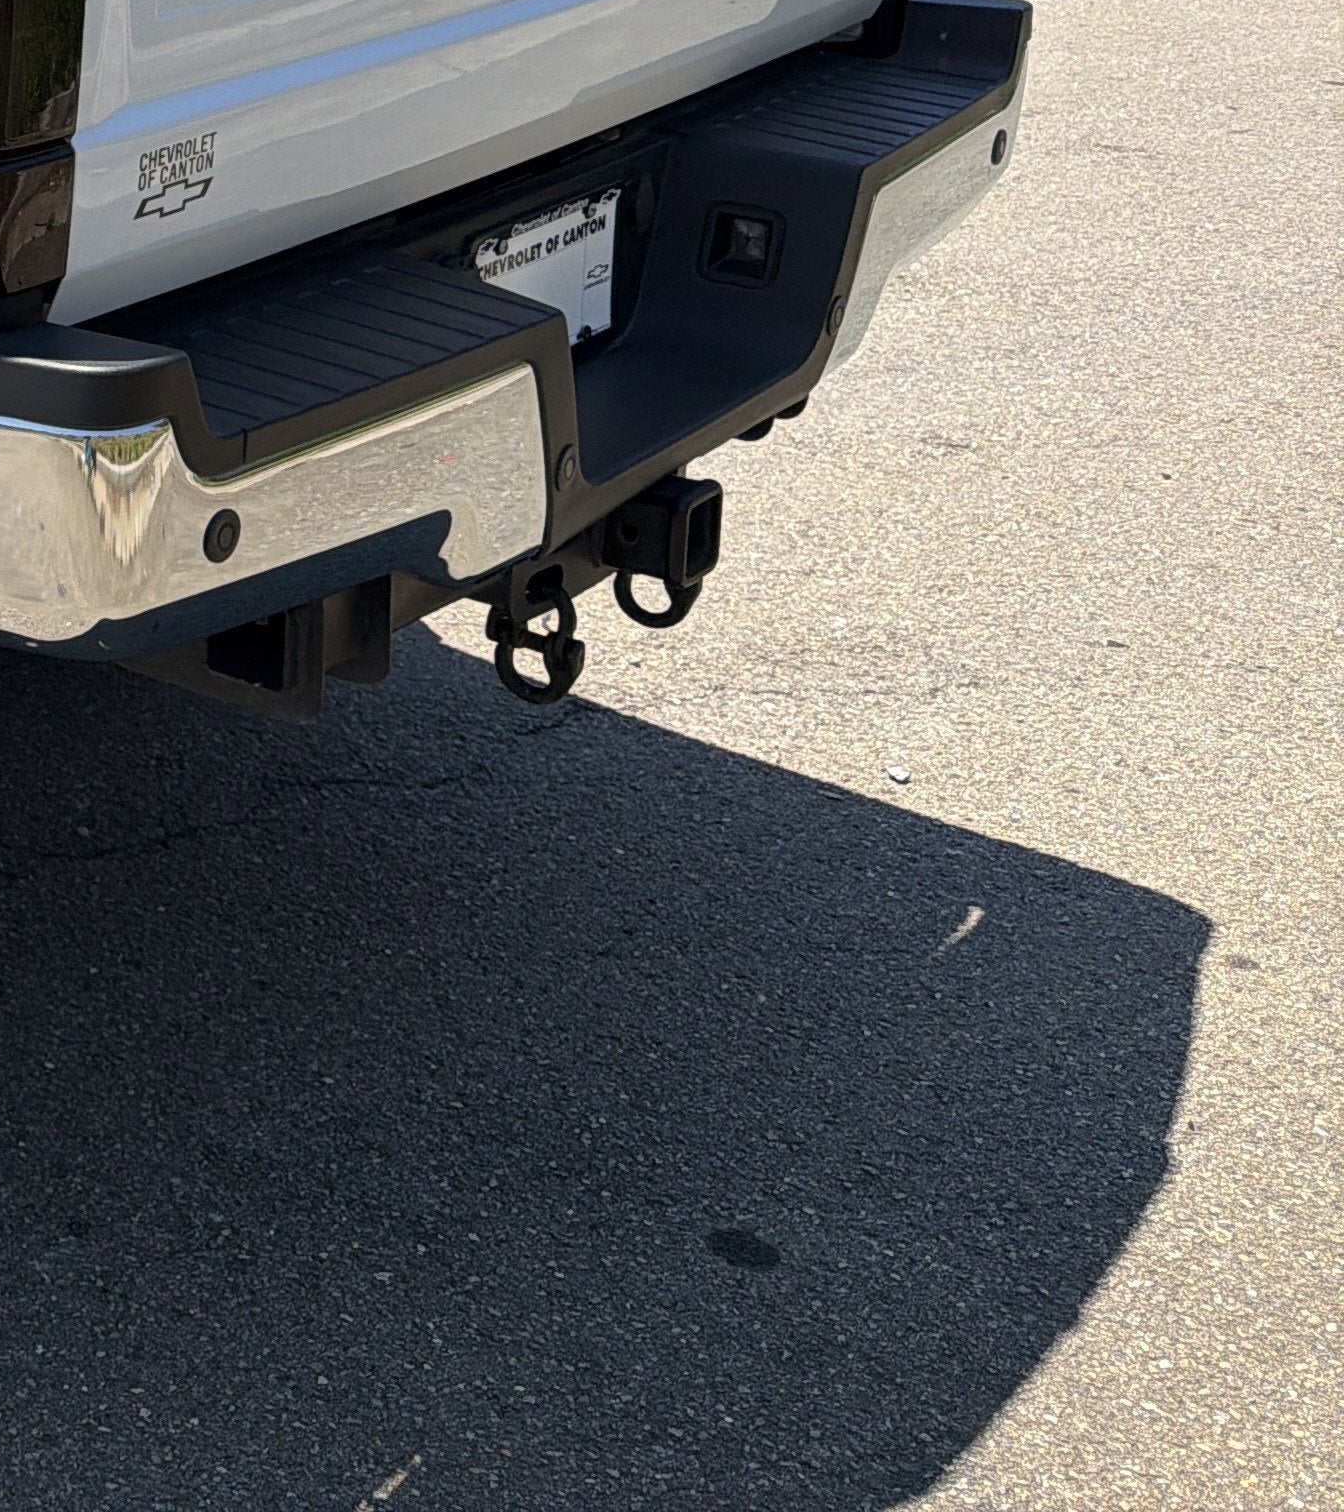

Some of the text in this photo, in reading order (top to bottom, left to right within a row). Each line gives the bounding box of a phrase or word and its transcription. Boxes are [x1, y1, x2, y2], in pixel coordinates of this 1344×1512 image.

[138, 152, 214, 191] OF CANTON
[139, 131, 217, 172] CHEVROLET
[545, 234, 560, 254] OF
[562, 214, 607, 246] CANTON
